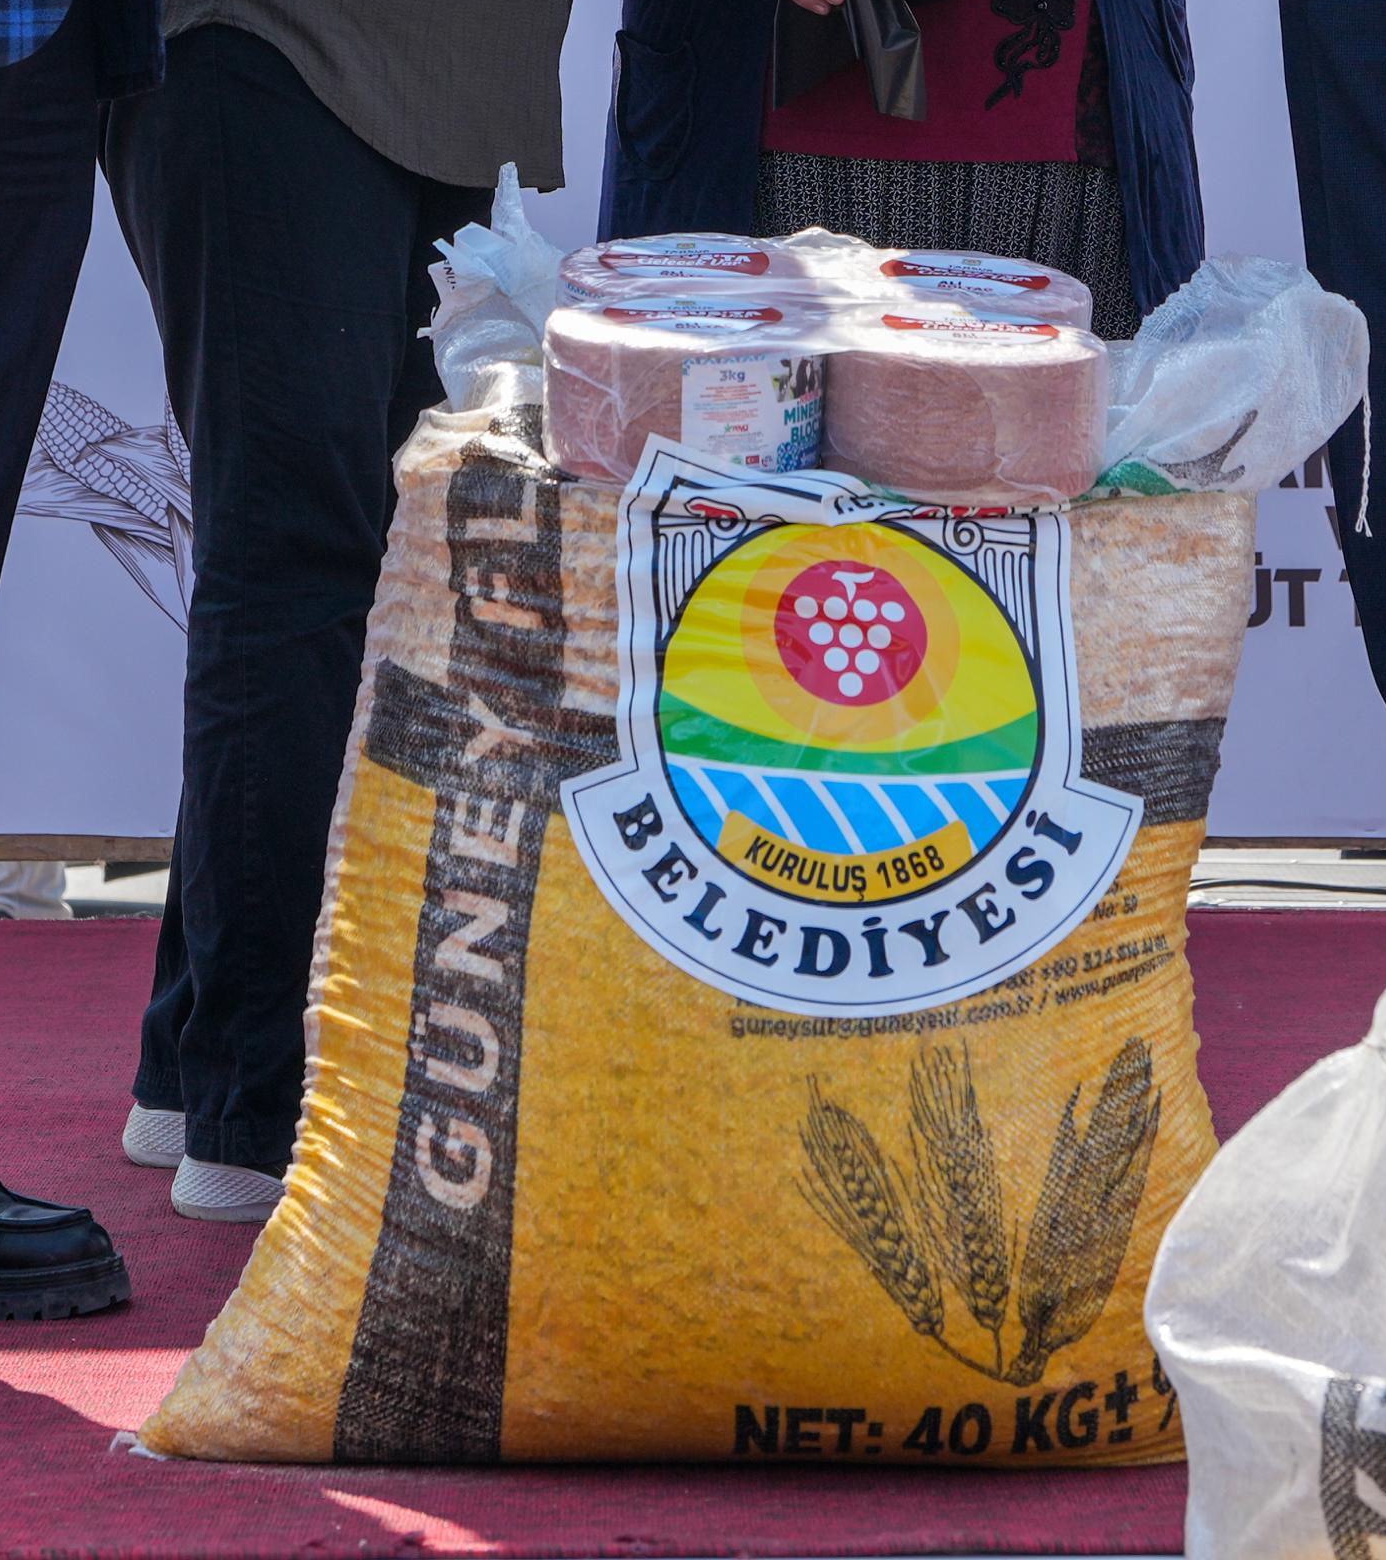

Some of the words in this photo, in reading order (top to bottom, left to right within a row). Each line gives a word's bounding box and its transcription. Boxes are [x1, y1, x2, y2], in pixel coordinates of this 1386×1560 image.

[613, 792, 1085, 980] BELEDİYESİ
[744, 840, 869, 902] KURULUŞ
[876, 844, 946, 892] 1868
[733, 1404, 883, 1455] NET:
[903, 1402, 993, 1456] 40
